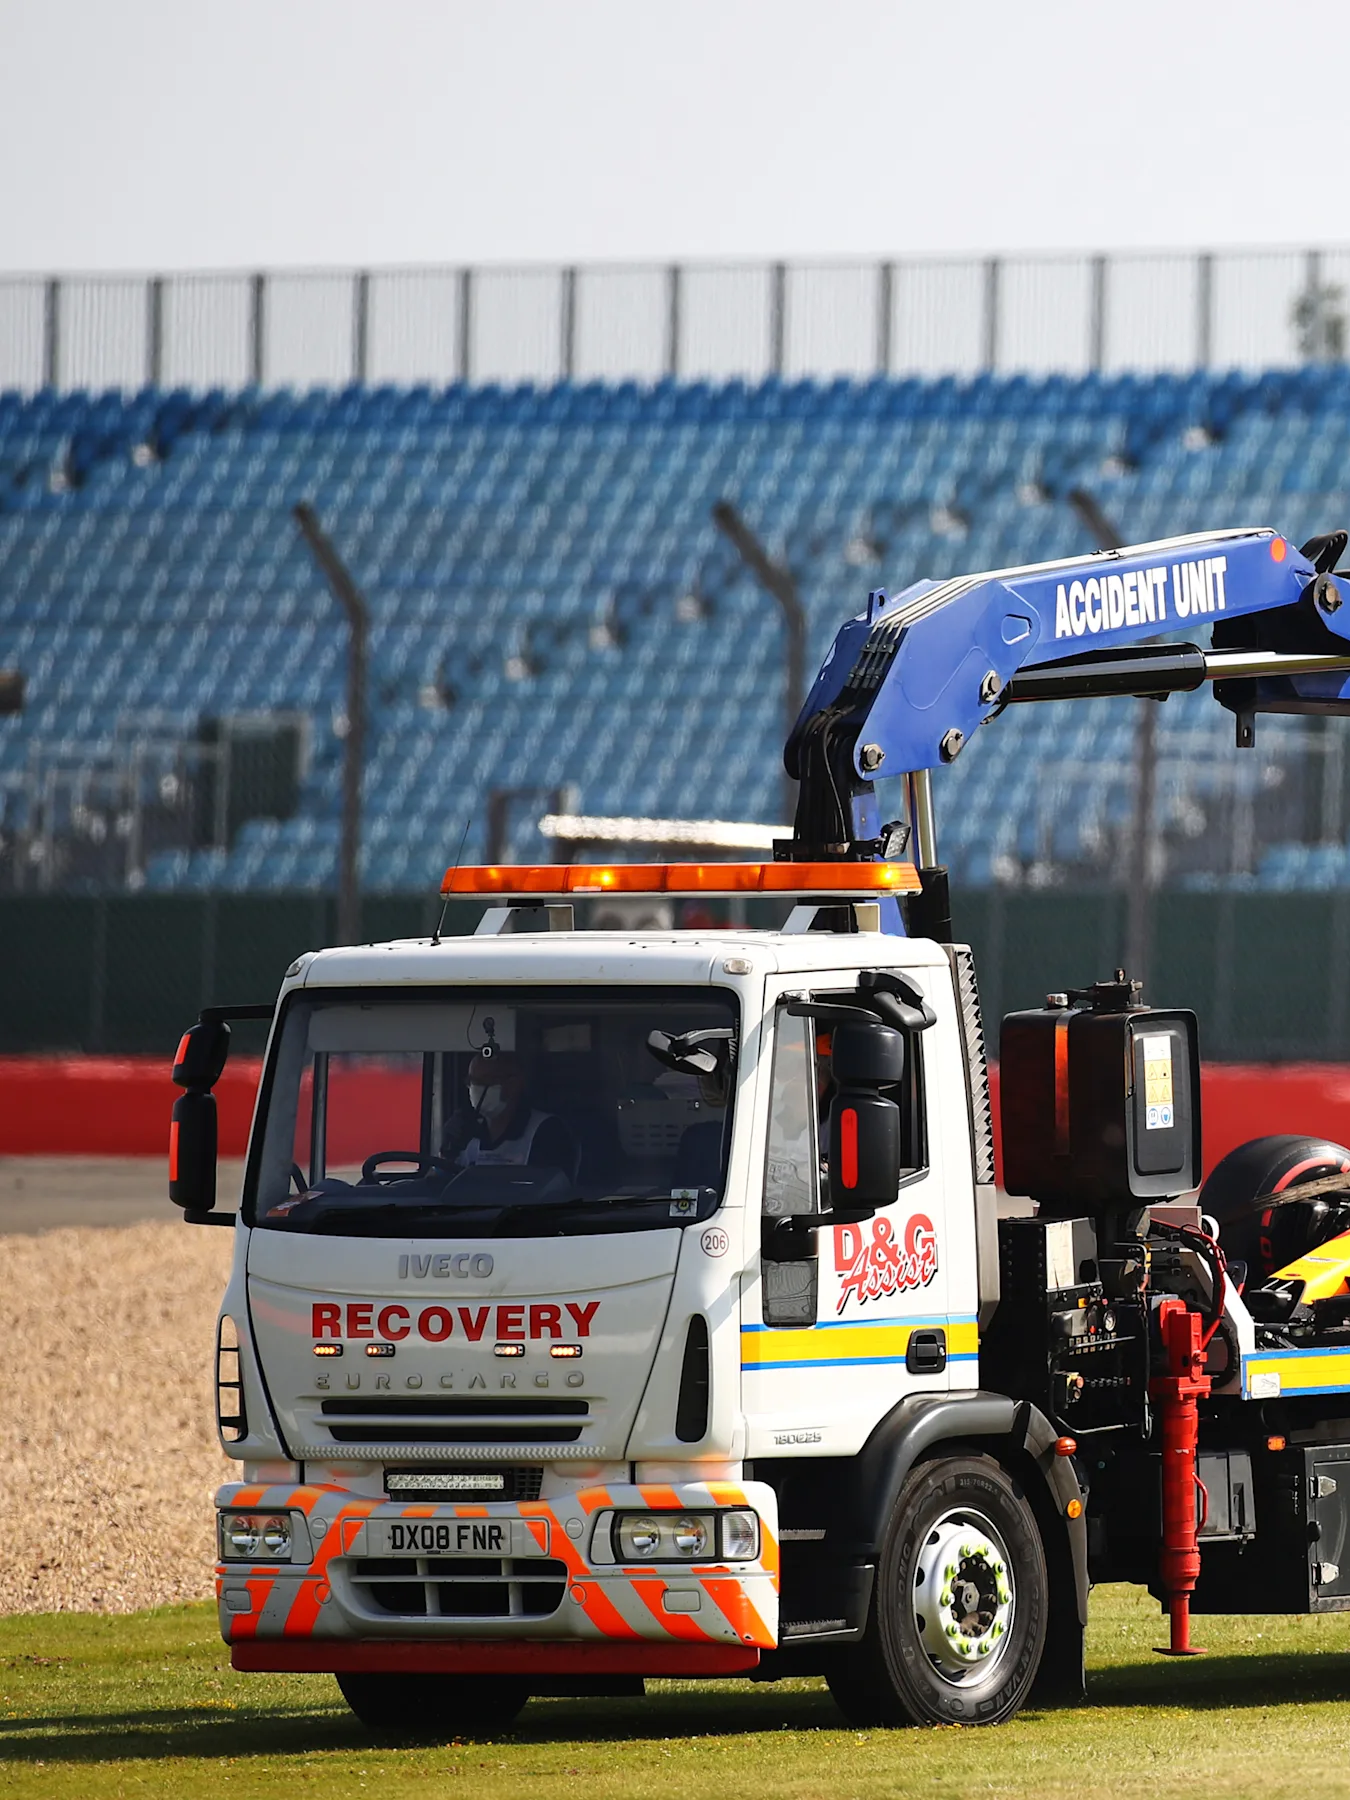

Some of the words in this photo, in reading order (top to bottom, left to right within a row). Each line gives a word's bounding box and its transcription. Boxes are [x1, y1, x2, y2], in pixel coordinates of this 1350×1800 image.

[1055, 566, 1168, 639] ACCIDENT
[1172, 556, 1227, 618] UNIT
[704, 1234, 726, 1251] 206
[833, 1213, 936, 1272] D&G
[398, 1253, 495, 1279] IVECO
[837, 1246, 939, 1315] Assist
[311, 1301, 601, 1342] RECOVERY
[314, 1370, 585, 1389] EUROCARGO
[391, 1524, 450, 1550] DX08
[456, 1525, 502, 1550] FNR
